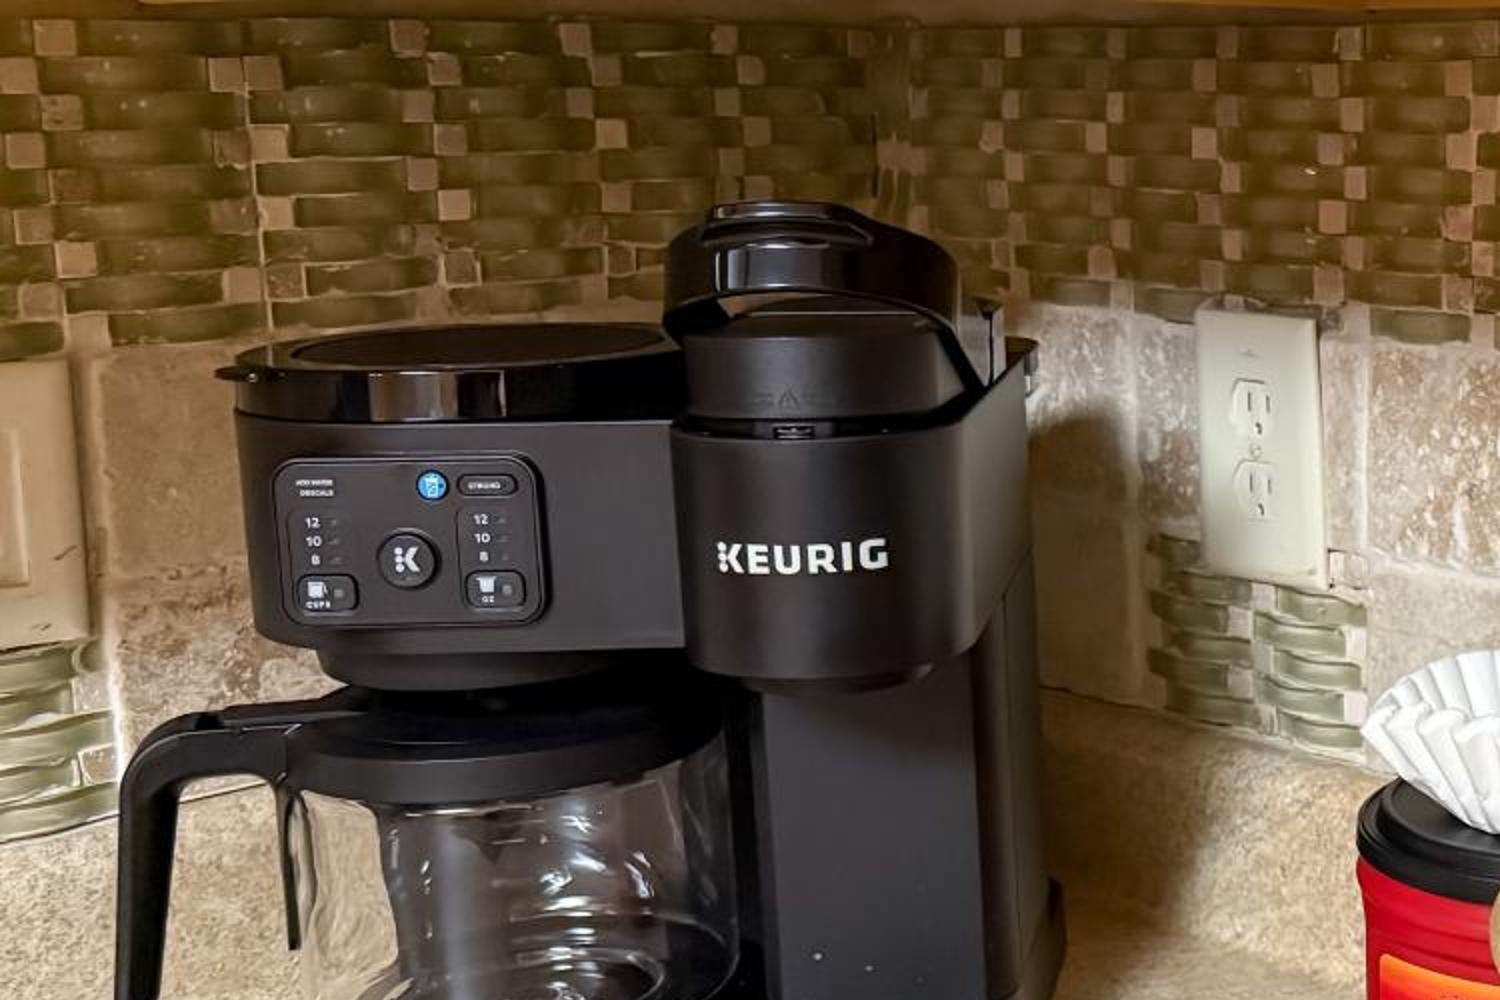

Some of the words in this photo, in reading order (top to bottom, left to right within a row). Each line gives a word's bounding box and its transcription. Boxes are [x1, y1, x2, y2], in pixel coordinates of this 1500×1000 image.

[300, 489, 334, 497] DESCALE
[305, 517, 320, 529] 12
[474, 513, 489, 525] 12
[305, 535, 322, 547] 10
[474, 532, 491, 543] 10
[393, 545, 420, 573] K
[716, 538, 889, 575] KEURIG
[305, 600, 331, 609] CUPS
